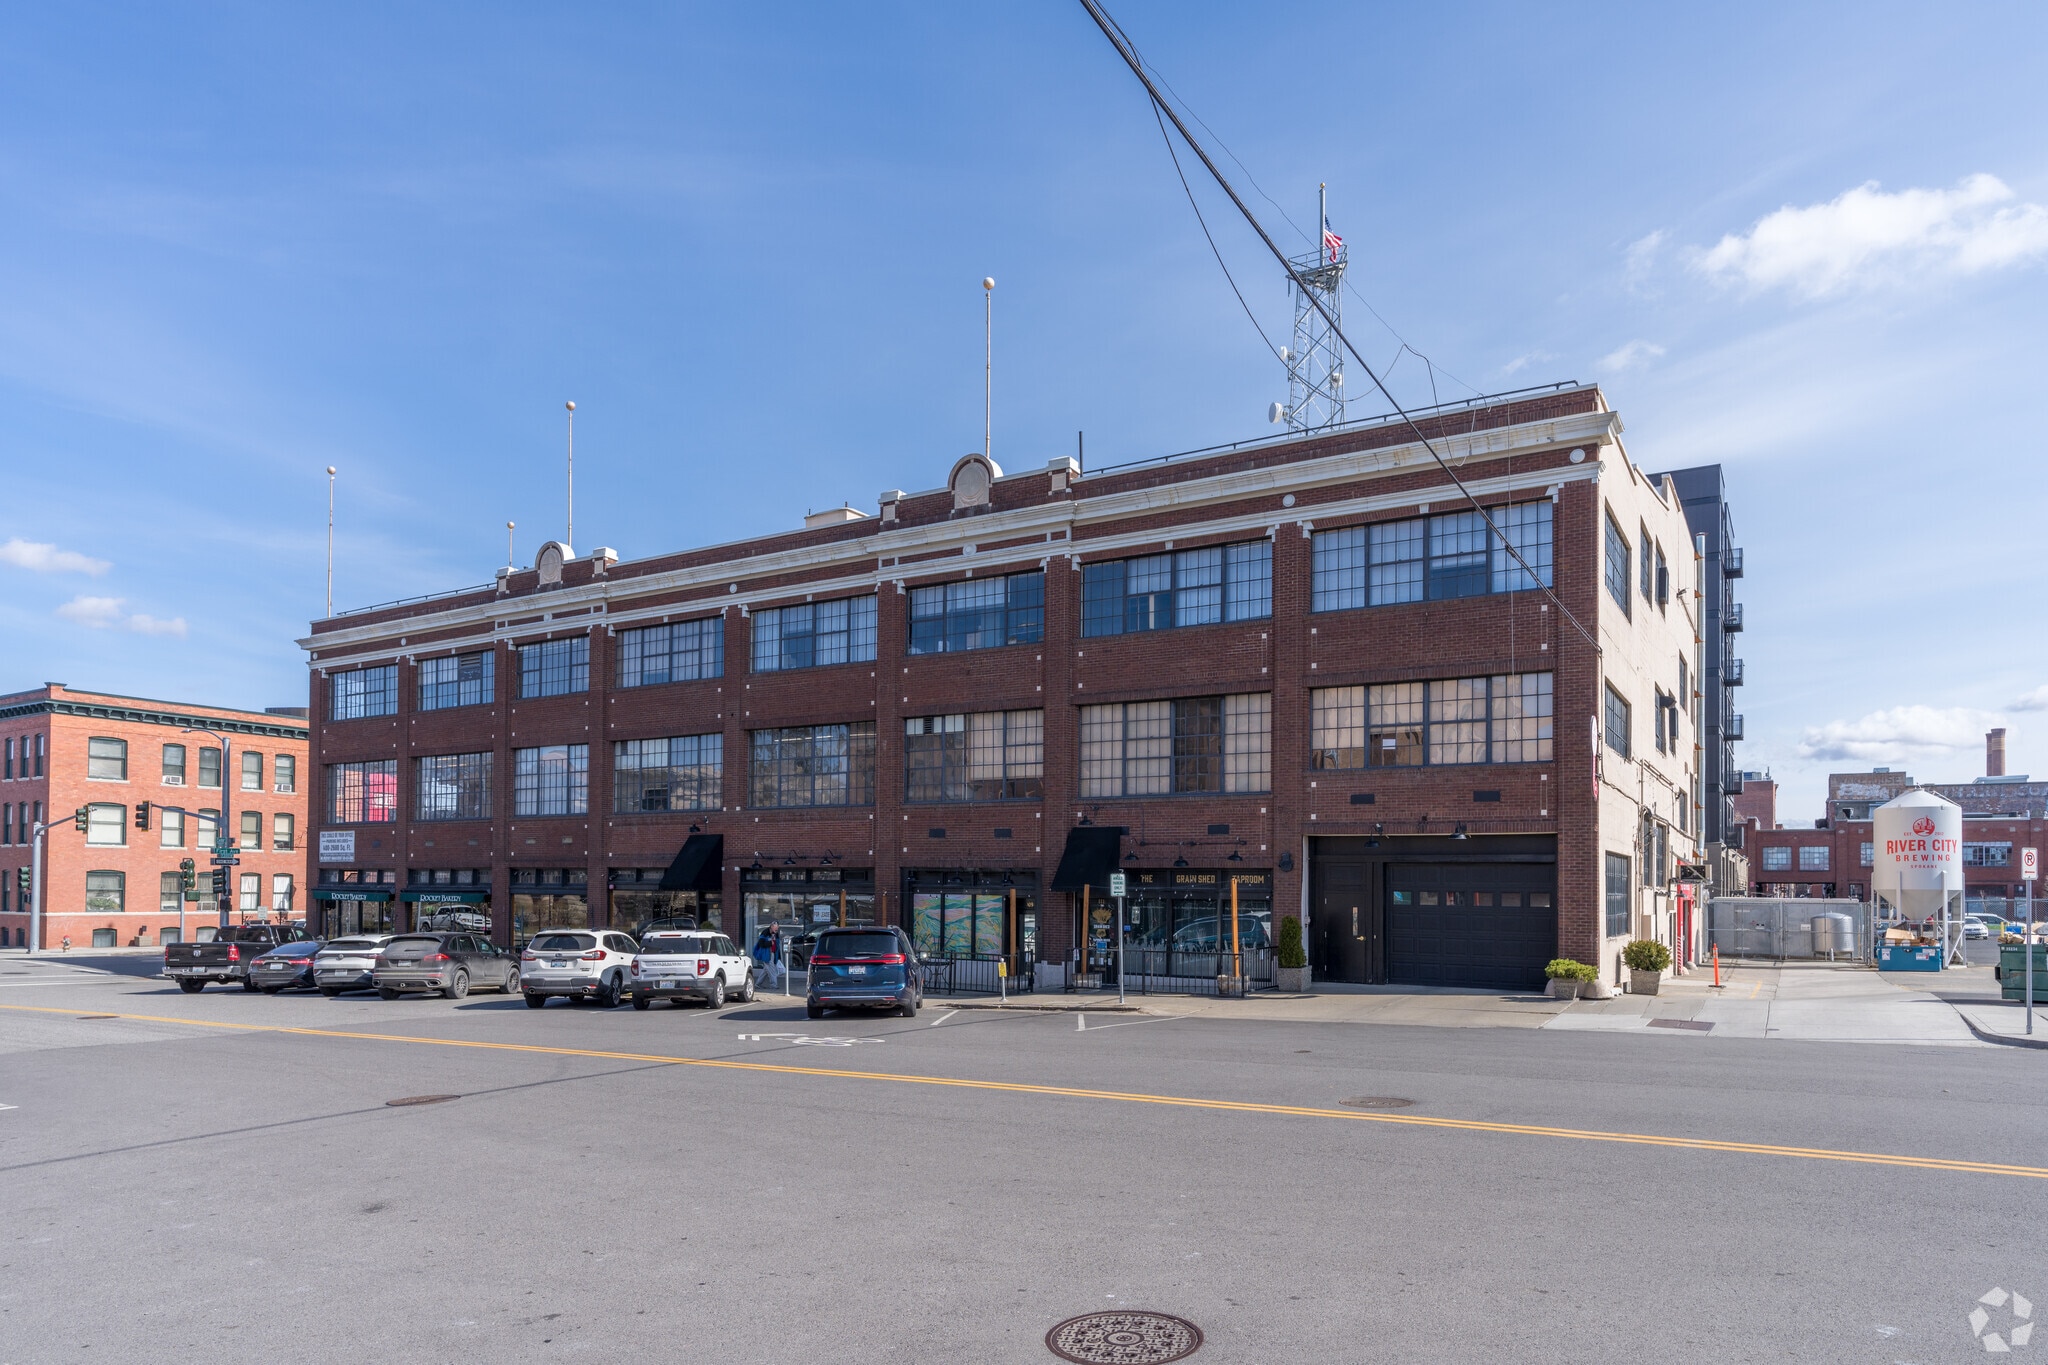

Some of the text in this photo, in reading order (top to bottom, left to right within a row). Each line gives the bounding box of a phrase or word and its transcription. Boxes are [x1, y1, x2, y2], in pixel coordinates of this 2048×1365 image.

[1887, 839, 1957, 855] RIVER CITY
[1896, 854, 1951, 862] BREWING
[1140, 874, 1153, 883] THE
[1176, 874, 1197, 883] GRAIN
[1197, 874, 1216, 883] SHED
